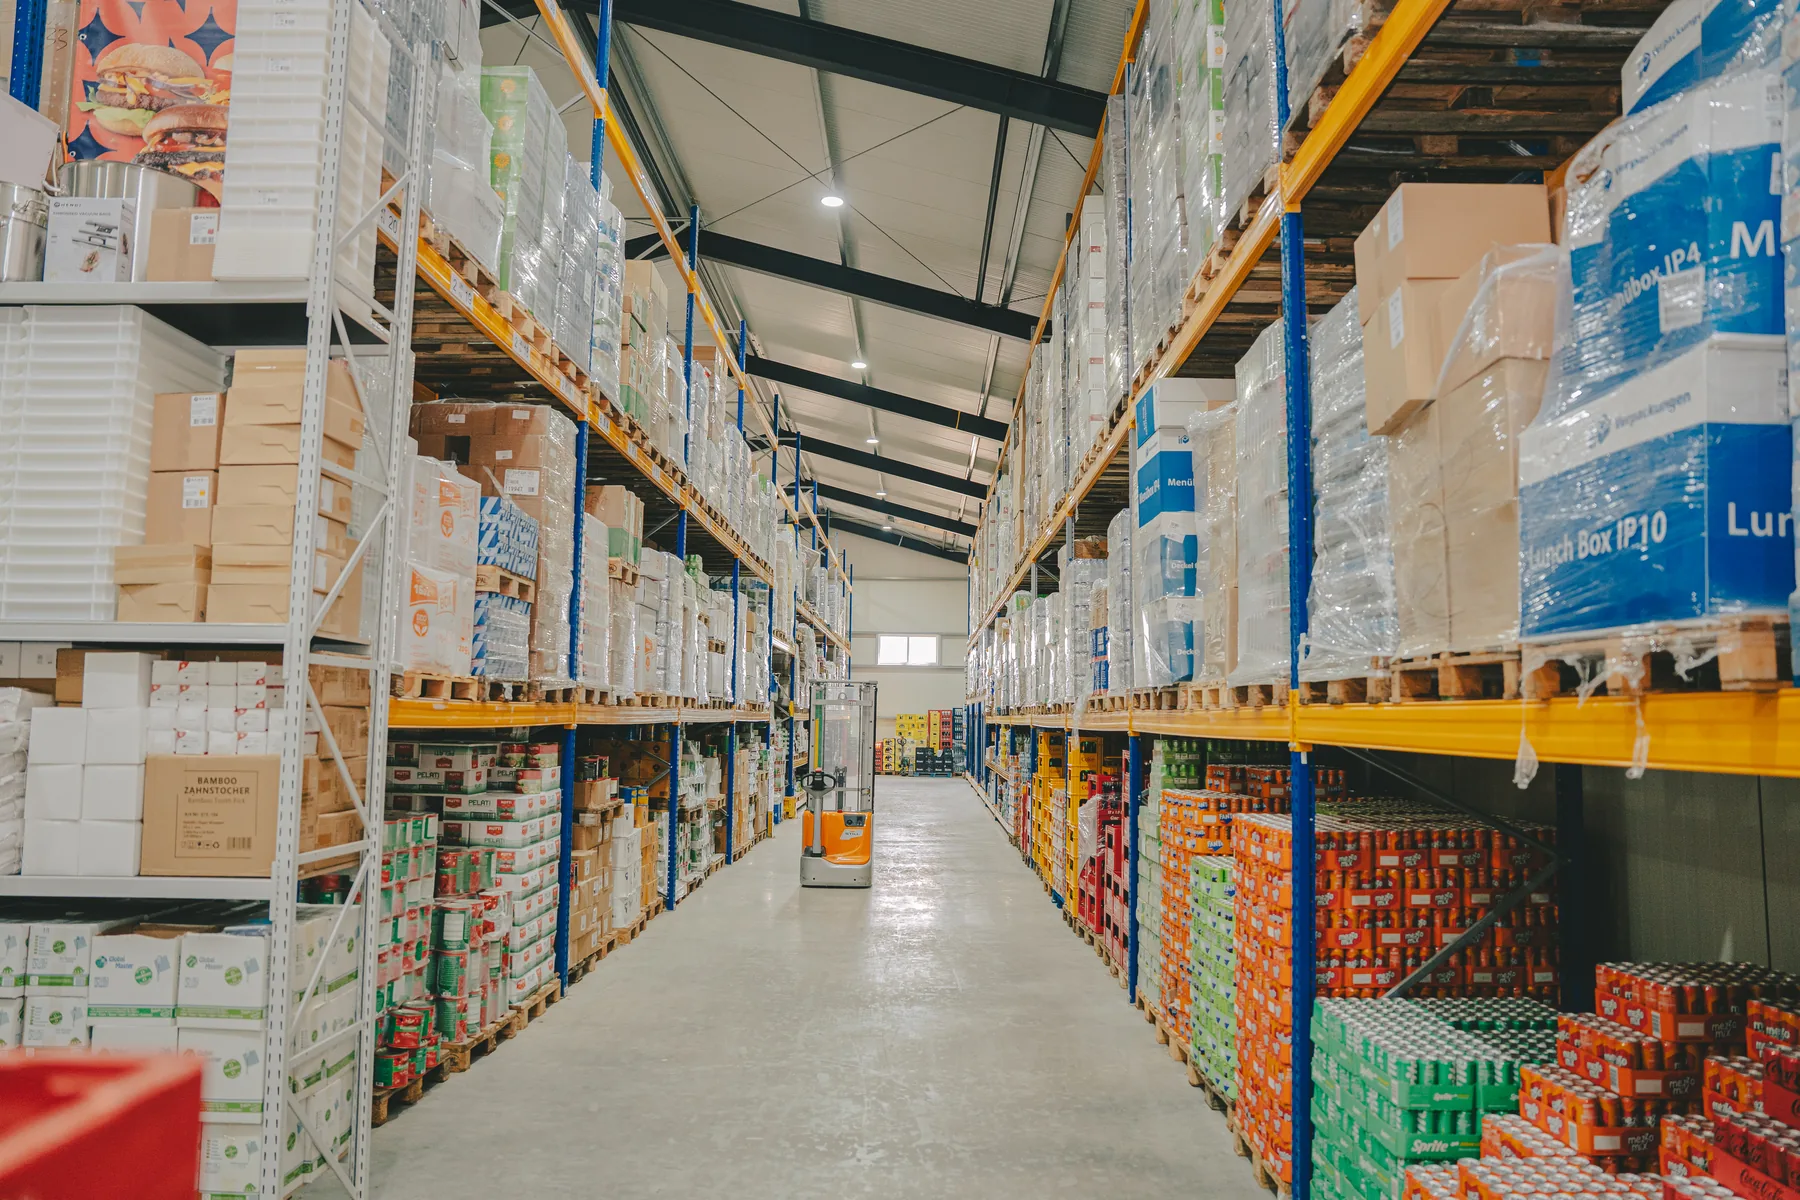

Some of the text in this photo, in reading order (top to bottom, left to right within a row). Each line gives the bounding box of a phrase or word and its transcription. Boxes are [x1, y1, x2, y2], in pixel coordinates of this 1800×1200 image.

[1168, 478, 1194, 486] Menü
[1578, 529, 1611, 560] Box
[1616, 510, 1668, 552] IP10
[416, 772, 440, 780] PELATI
[197, 776, 238, 785] BAMBOO
[184, 787, 250, 795] ZAHNSTOCHER
[1628, 1133, 1654, 1144] mezzo
[1411, 1139, 1448, 1154] Sprite
[1631, 1143, 1648, 1151] mix
